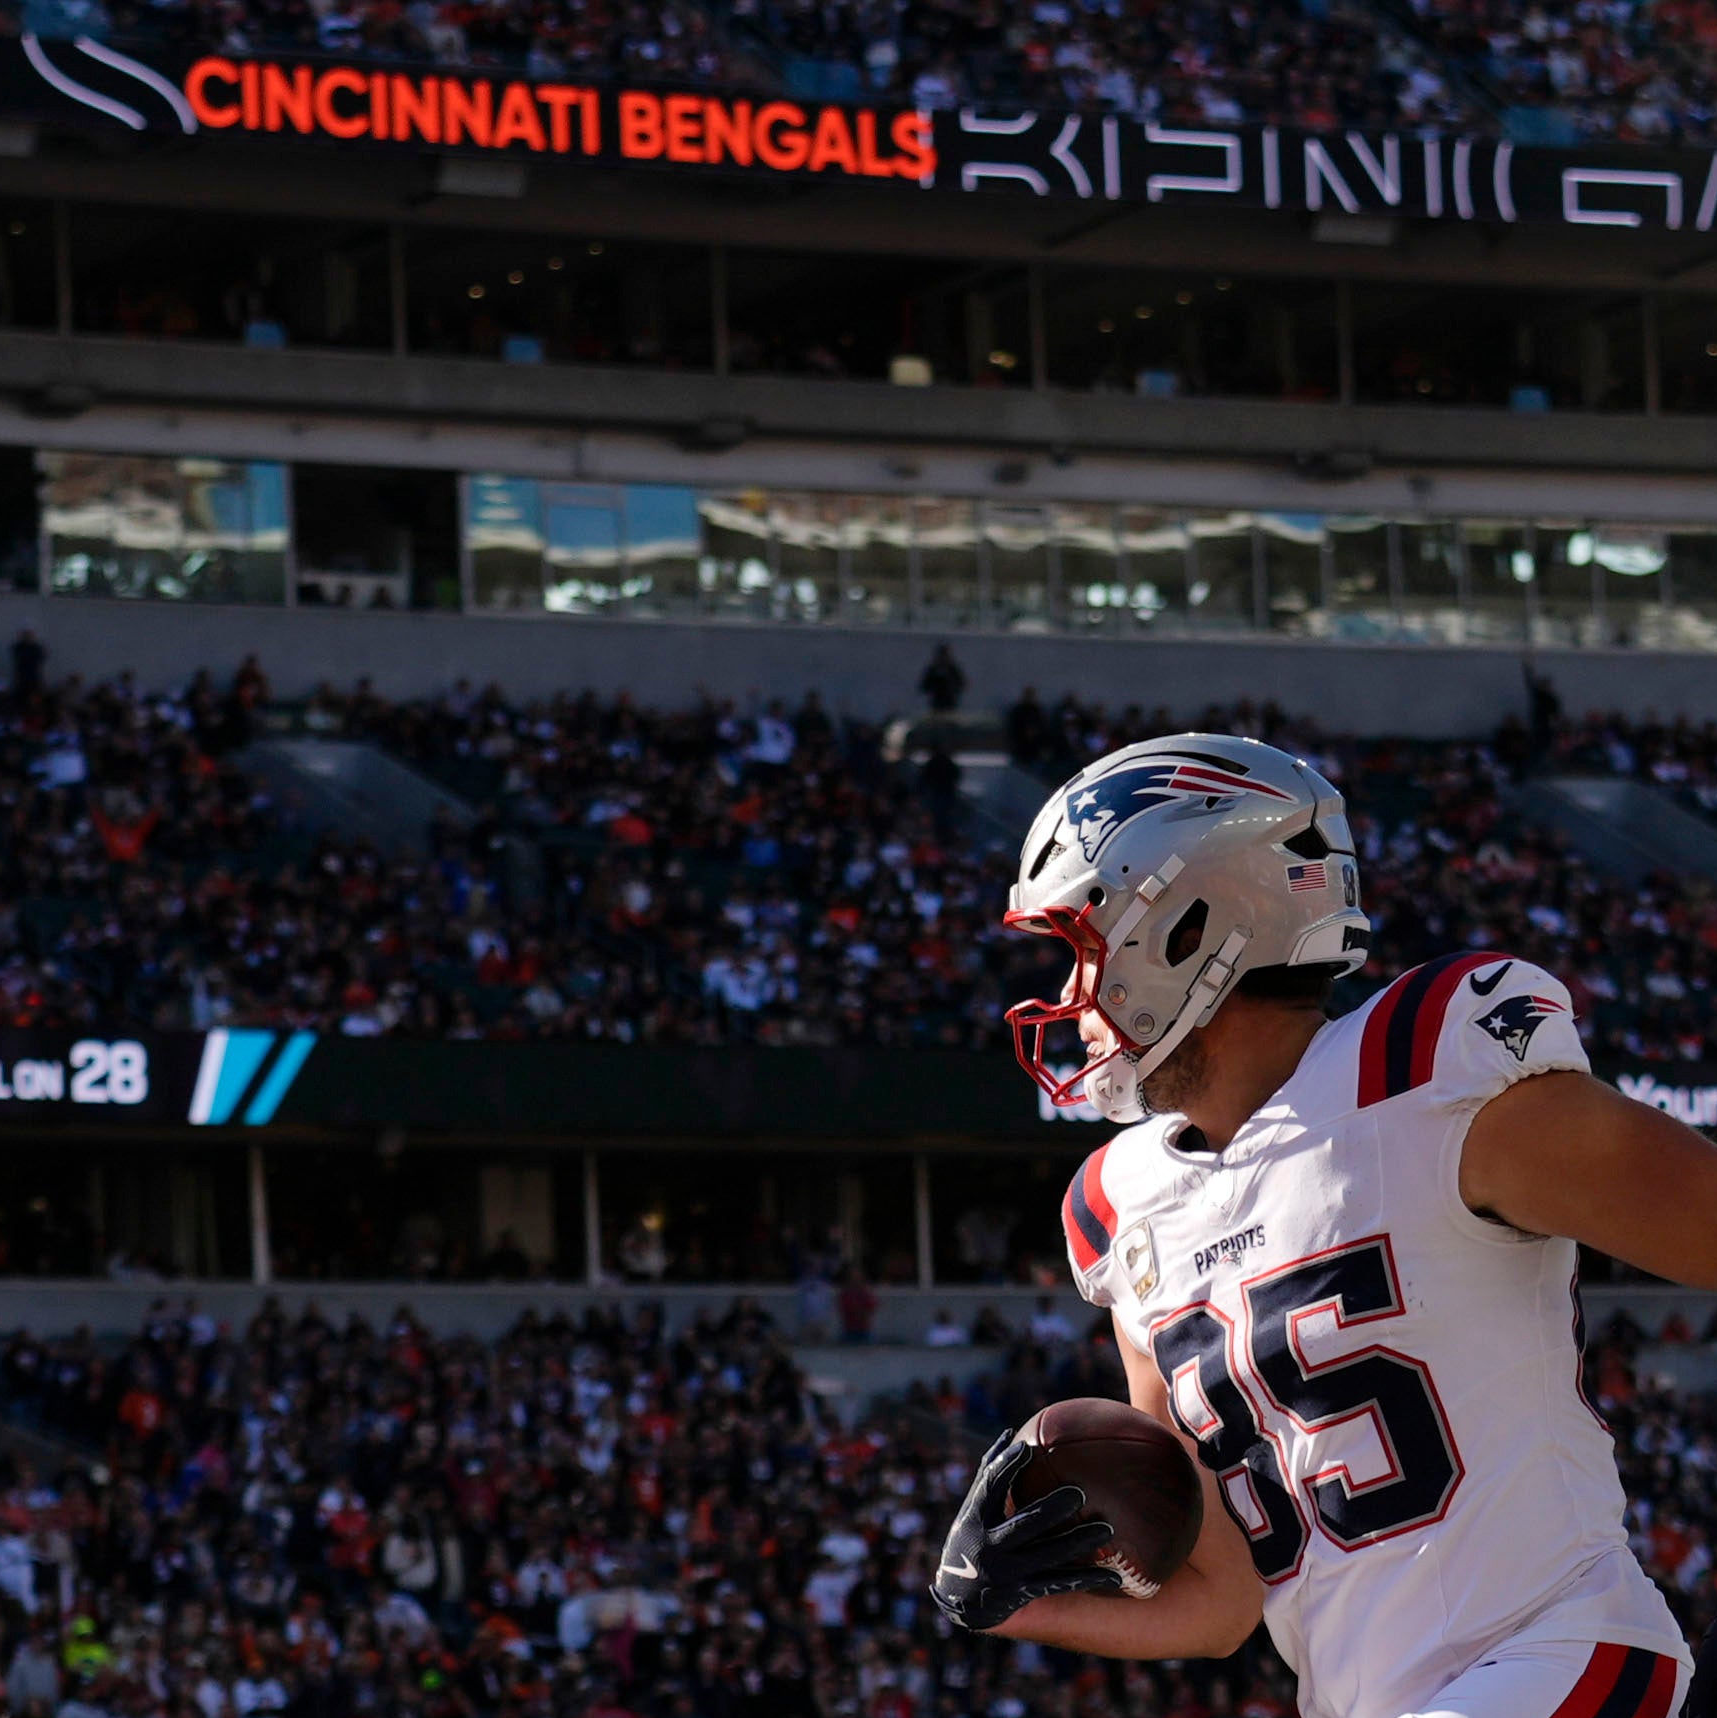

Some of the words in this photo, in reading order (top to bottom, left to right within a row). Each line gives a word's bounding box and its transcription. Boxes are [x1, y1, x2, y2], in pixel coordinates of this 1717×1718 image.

[183, 56, 600, 157] CINCINNATI
[618, 91, 938, 181] BENGALS
[69, 1038, 149, 1105] 28
[1194, 1224, 1266, 1276] PATRIOTS
[1148, 1232, 1467, 1587] 85
